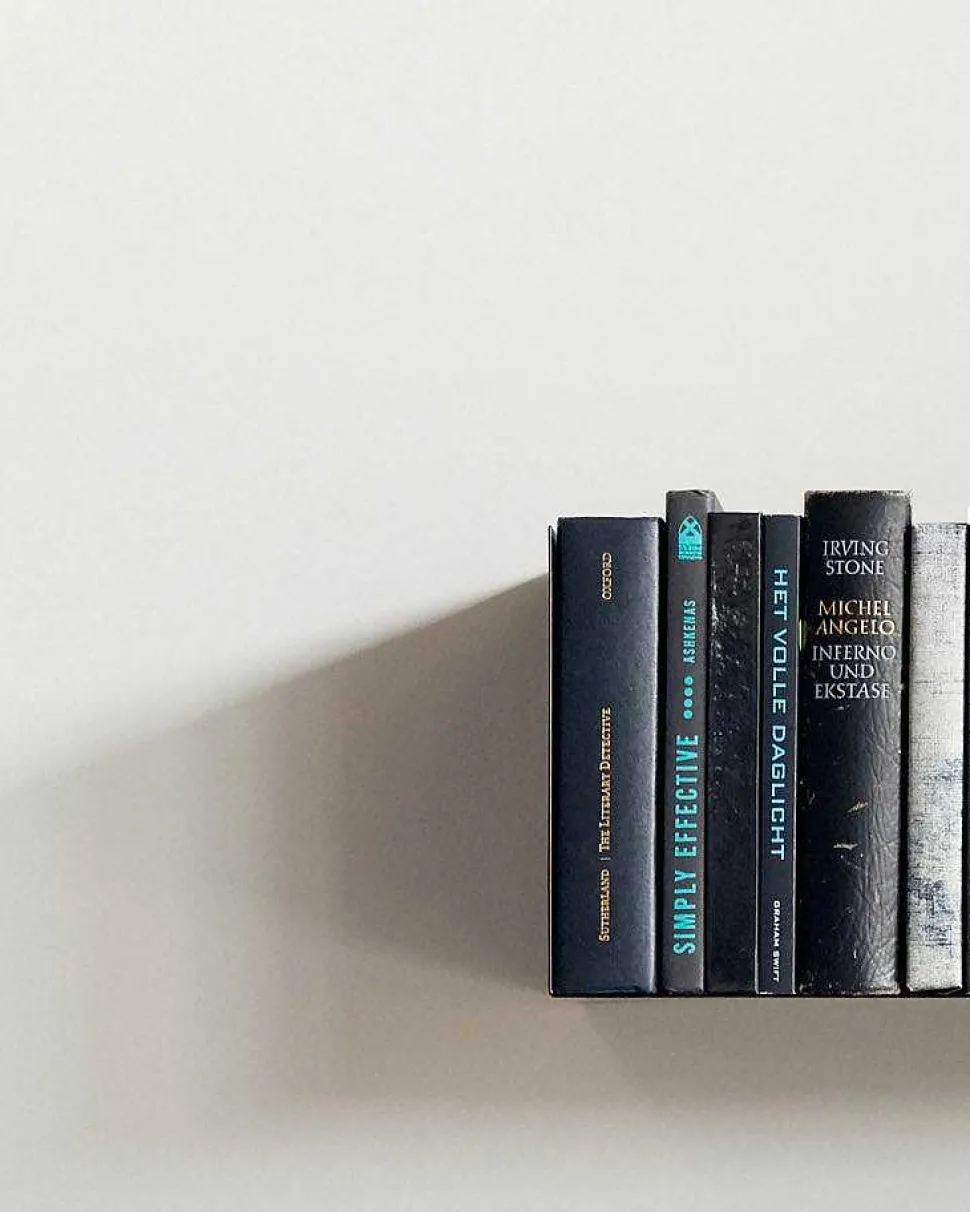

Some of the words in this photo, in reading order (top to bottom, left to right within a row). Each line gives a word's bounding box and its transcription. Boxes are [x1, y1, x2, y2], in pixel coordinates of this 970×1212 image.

[822, 539, 890, 558] IRVING
[825, 557, 885, 576] STONE
[601, 552, 612, 600] OXFORD
[773, 568, 788, 620] HET
[816, 617, 895, 637] ANGELO
[818, 600, 892, 618] MICHEL
[683, 600, 696, 663] ASHKENAS
[772, 627, 788, 714] VOLLE
[811, 644, 897, 662] INFERNO
[829, 663, 875, 681] UND
[814, 682, 891, 700] EKSTASE
[674, 734, 699, 857] EFFECTIVE
[771, 724, 786, 861] DAGLICHT
[673, 869, 697, 955] SIMPLY
[772, 900, 780, 947] GRAHAM
[772, 950, 780, 983] SWIFT
